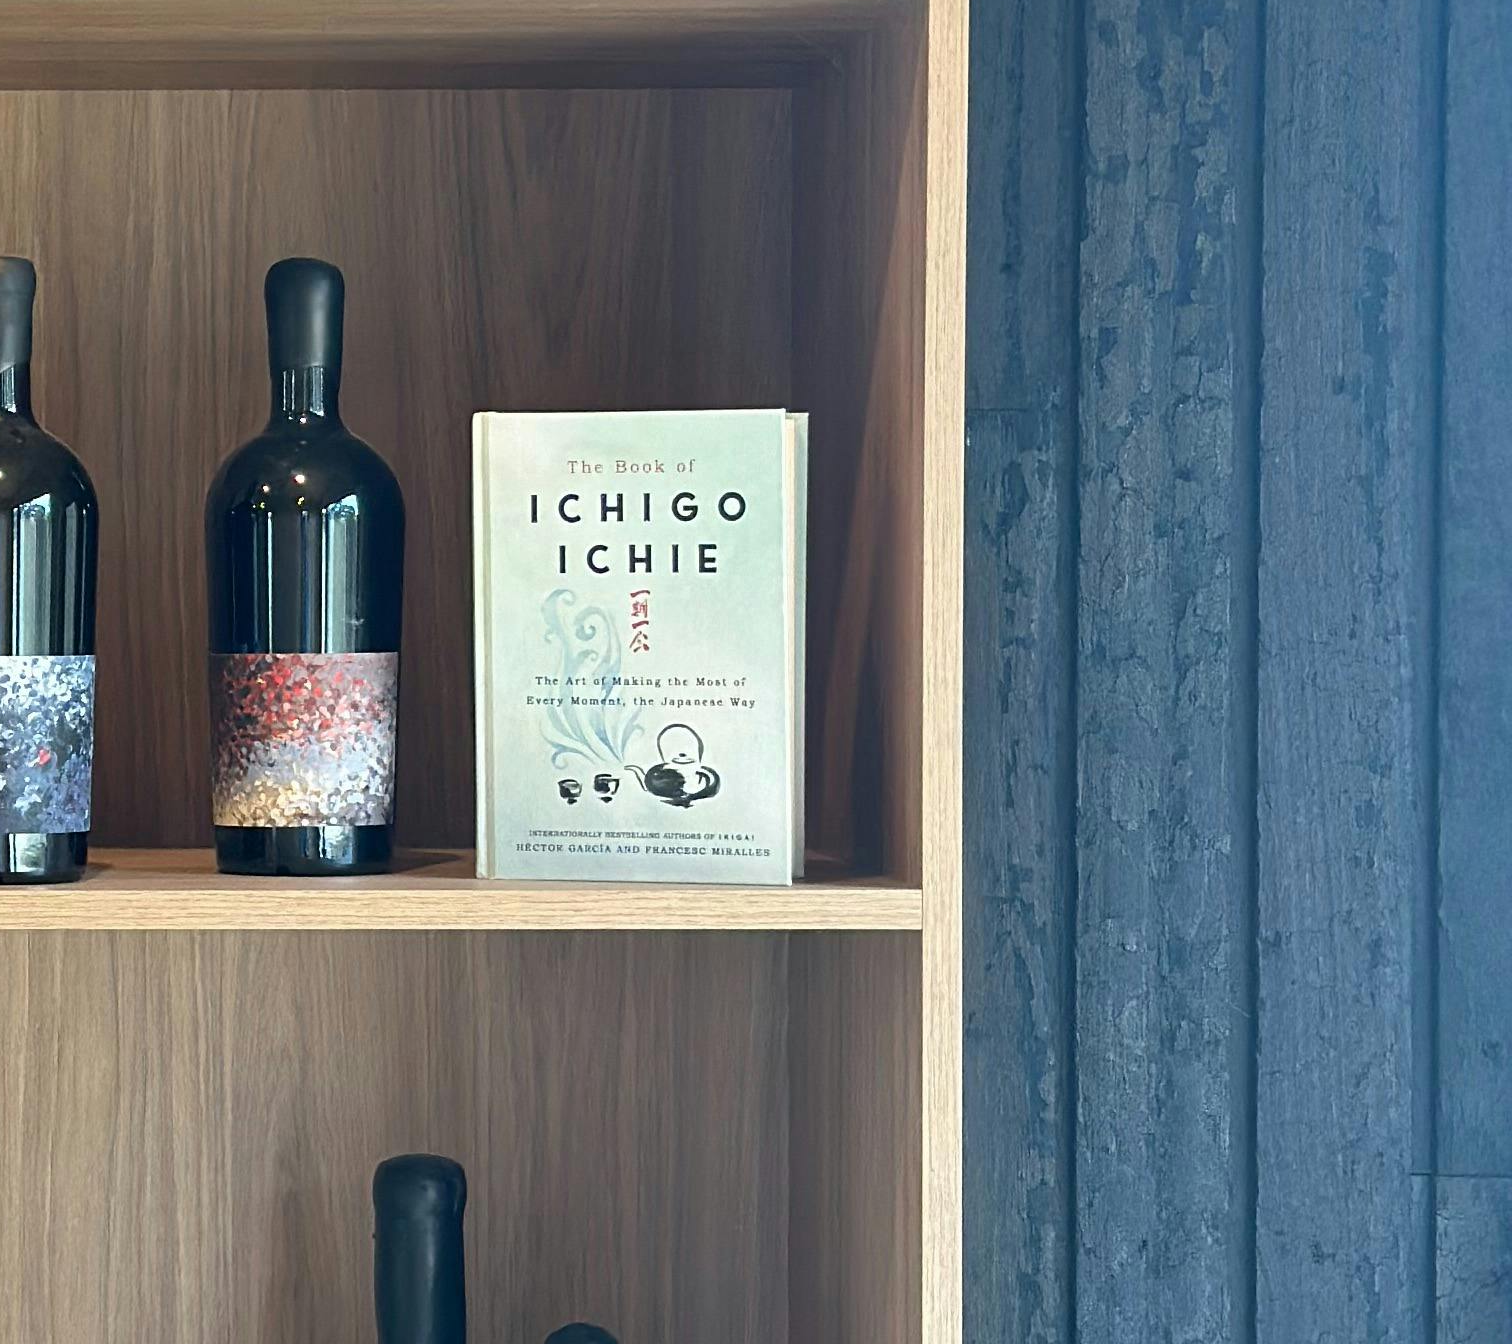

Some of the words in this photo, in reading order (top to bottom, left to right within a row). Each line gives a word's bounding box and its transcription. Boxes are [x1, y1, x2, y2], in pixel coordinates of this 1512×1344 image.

[567, 460, 603, 474] The
[616, 459, 665, 474] Book
[677, 459, 696, 473] of
[531, 491, 746, 523] ICHIGO
[559, 543, 717, 574] ICHIE
[535, 676, 559, 686] The
[566, 676, 586, 686] Art
[593, 676, 605, 686] of
[612, 676, 661, 688] Making
[668, 677, 688, 687] the
[696, 677, 727, 687] Most
[734, 677, 747, 687] of
[526, 696, 564, 708] Every
[571, 696, 626, 708] Moment,
[633, 697, 654, 707] the
[661, 697, 724, 709] Japanese
[730, 697, 756, 709] Way
[529, 830, 602, 838] INTERNATIONALLY
[605, 831, 660, 839] BESTSELLING
[663, 832, 701, 840] AUTHORS
[616, 845, 640, 854] AND
[645, 846, 706, 855] FRANCESC
[711, 847, 771, 857] MIRALLES
